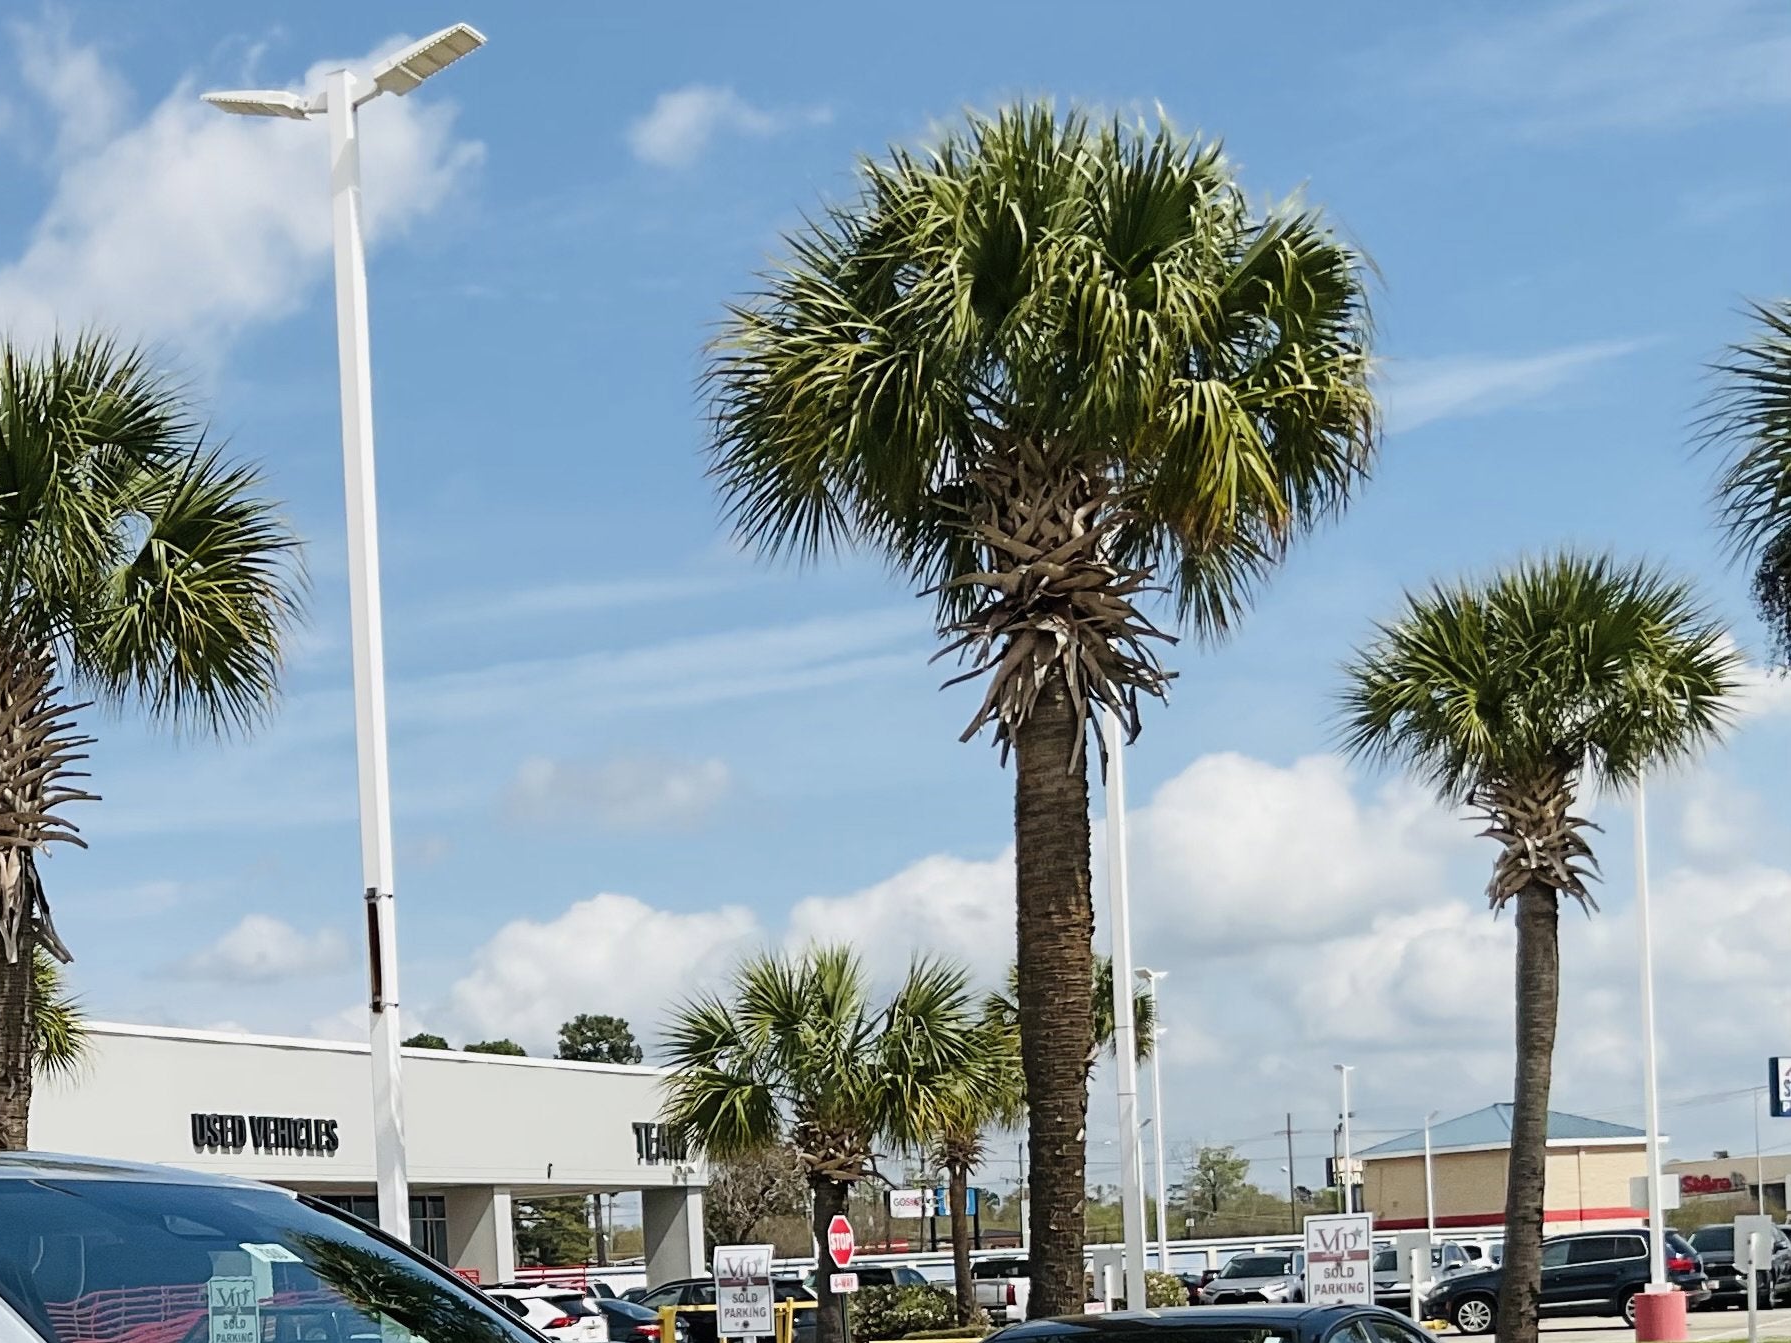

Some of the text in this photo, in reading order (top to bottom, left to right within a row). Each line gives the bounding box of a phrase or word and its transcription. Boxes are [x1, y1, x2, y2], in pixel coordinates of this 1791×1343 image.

[190, 1113, 339, 1152] USED VEHICLES
[830, 1232, 852, 1250] STOP
[1323, 1267, 1355, 1279] SOLD
[833, 1277, 854, 1288] 4-WAY
[1314, 1282, 1365, 1296] PARKING
[732, 1292, 759, 1304] SOLD
[724, 1306, 766, 1319] PARKING
[223, 1319, 246, 1330] SOLD
[216, 1332, 253, 1343] PARKING
